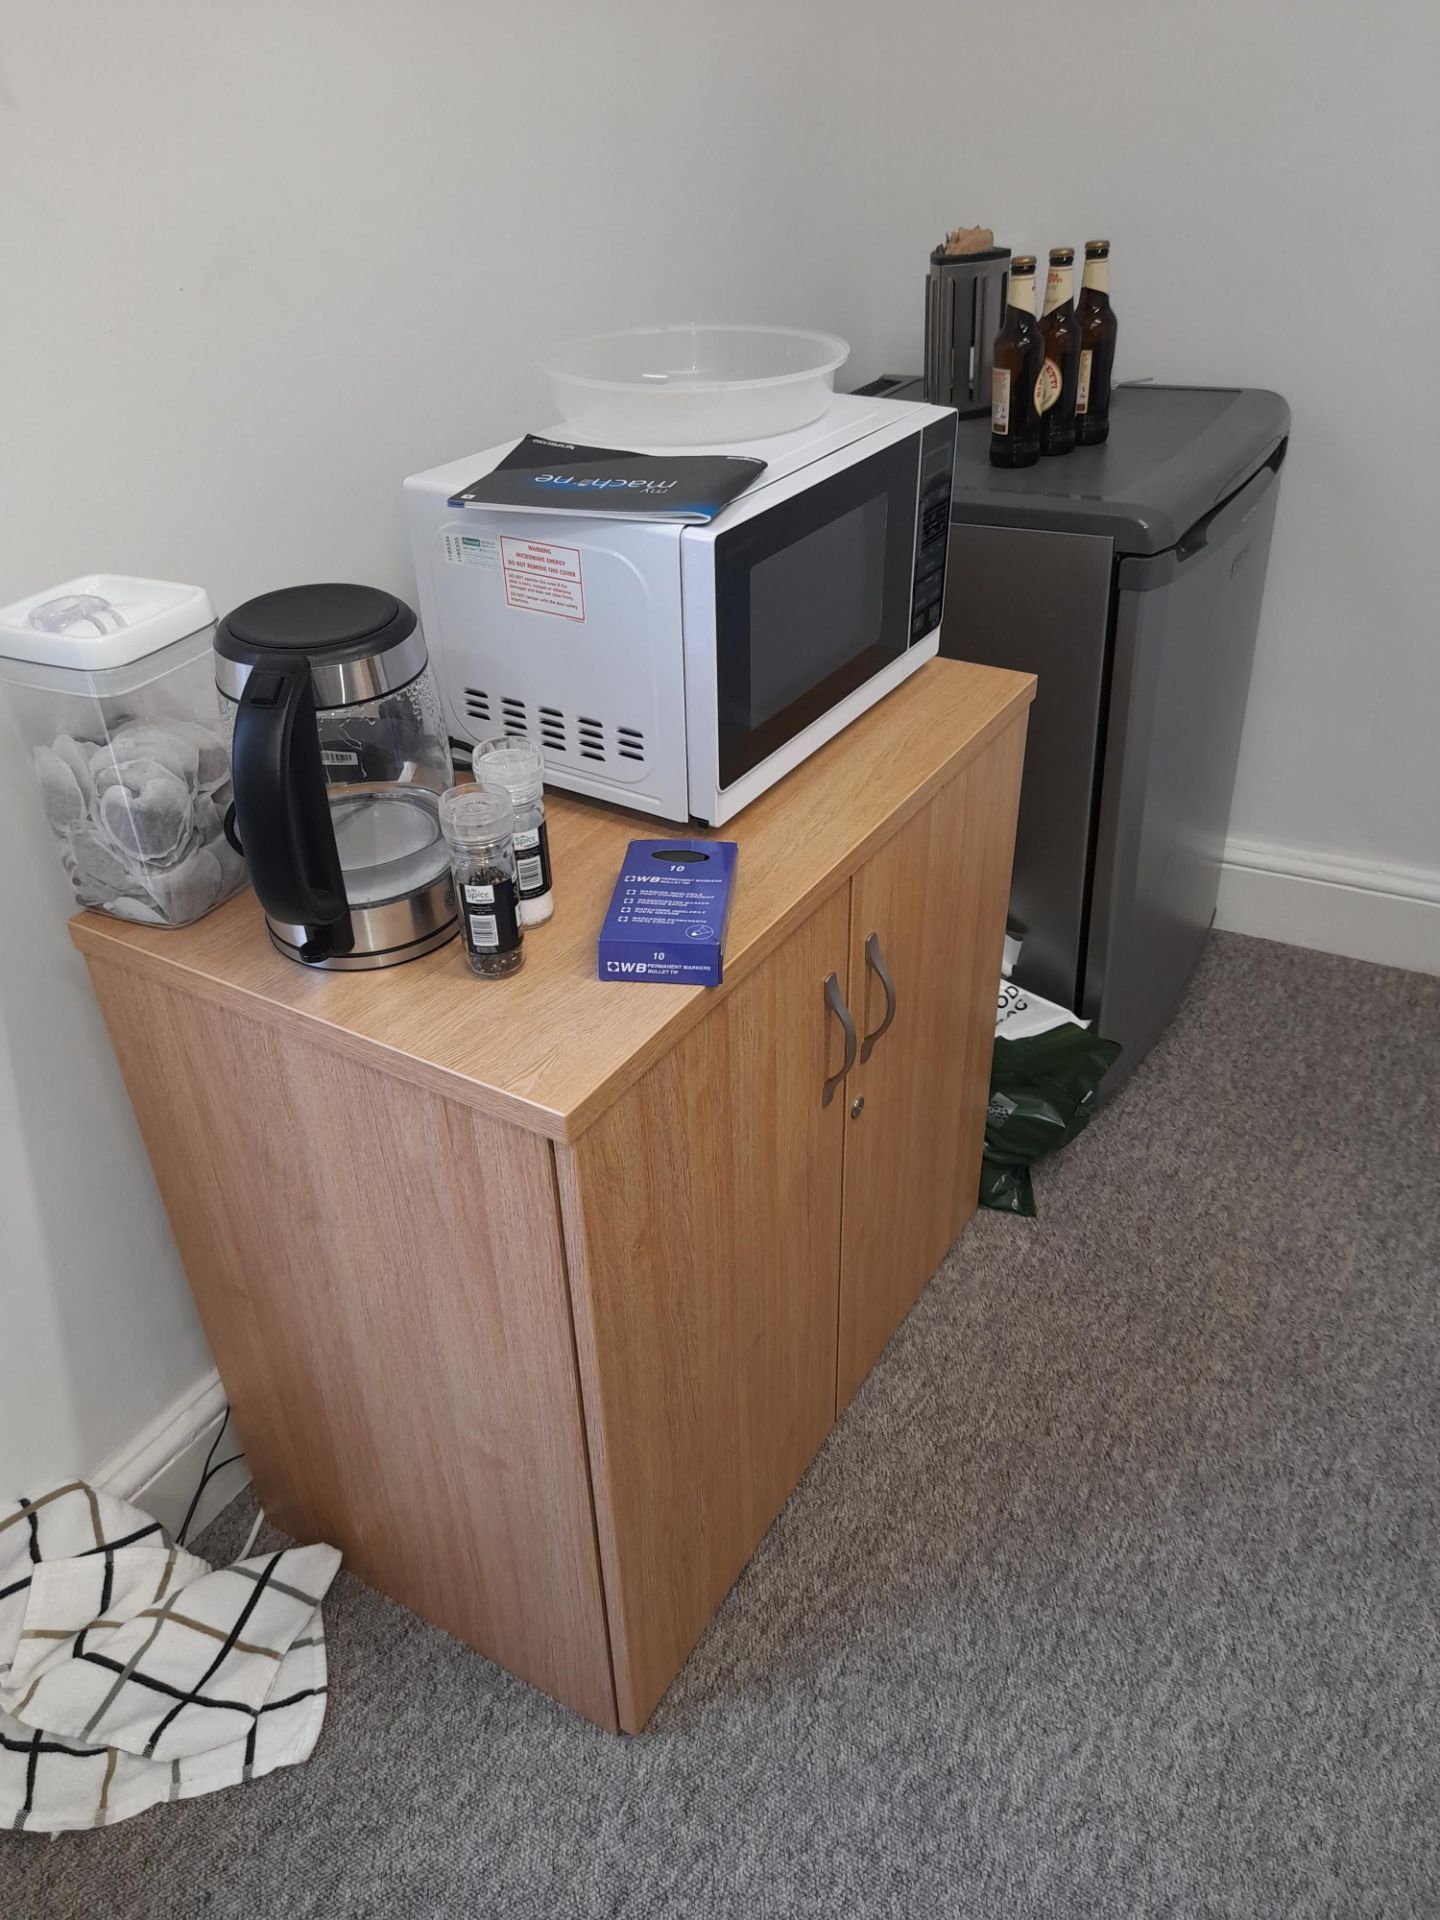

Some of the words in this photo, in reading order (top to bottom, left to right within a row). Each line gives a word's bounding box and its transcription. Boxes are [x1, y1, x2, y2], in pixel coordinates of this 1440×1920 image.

[640, 487, 668, 495] my
[527, 544, 551, 555] WARNING
[515, 551, 545, 562] MICROWAVE
[546, 557, 566, 566] ENERGY
[527, 562, 547, 571] REMOVE
[559, 569, 576, 577] COVER
[652, 951, 665, 960] 10
[620, 962, 647, 973] WB
